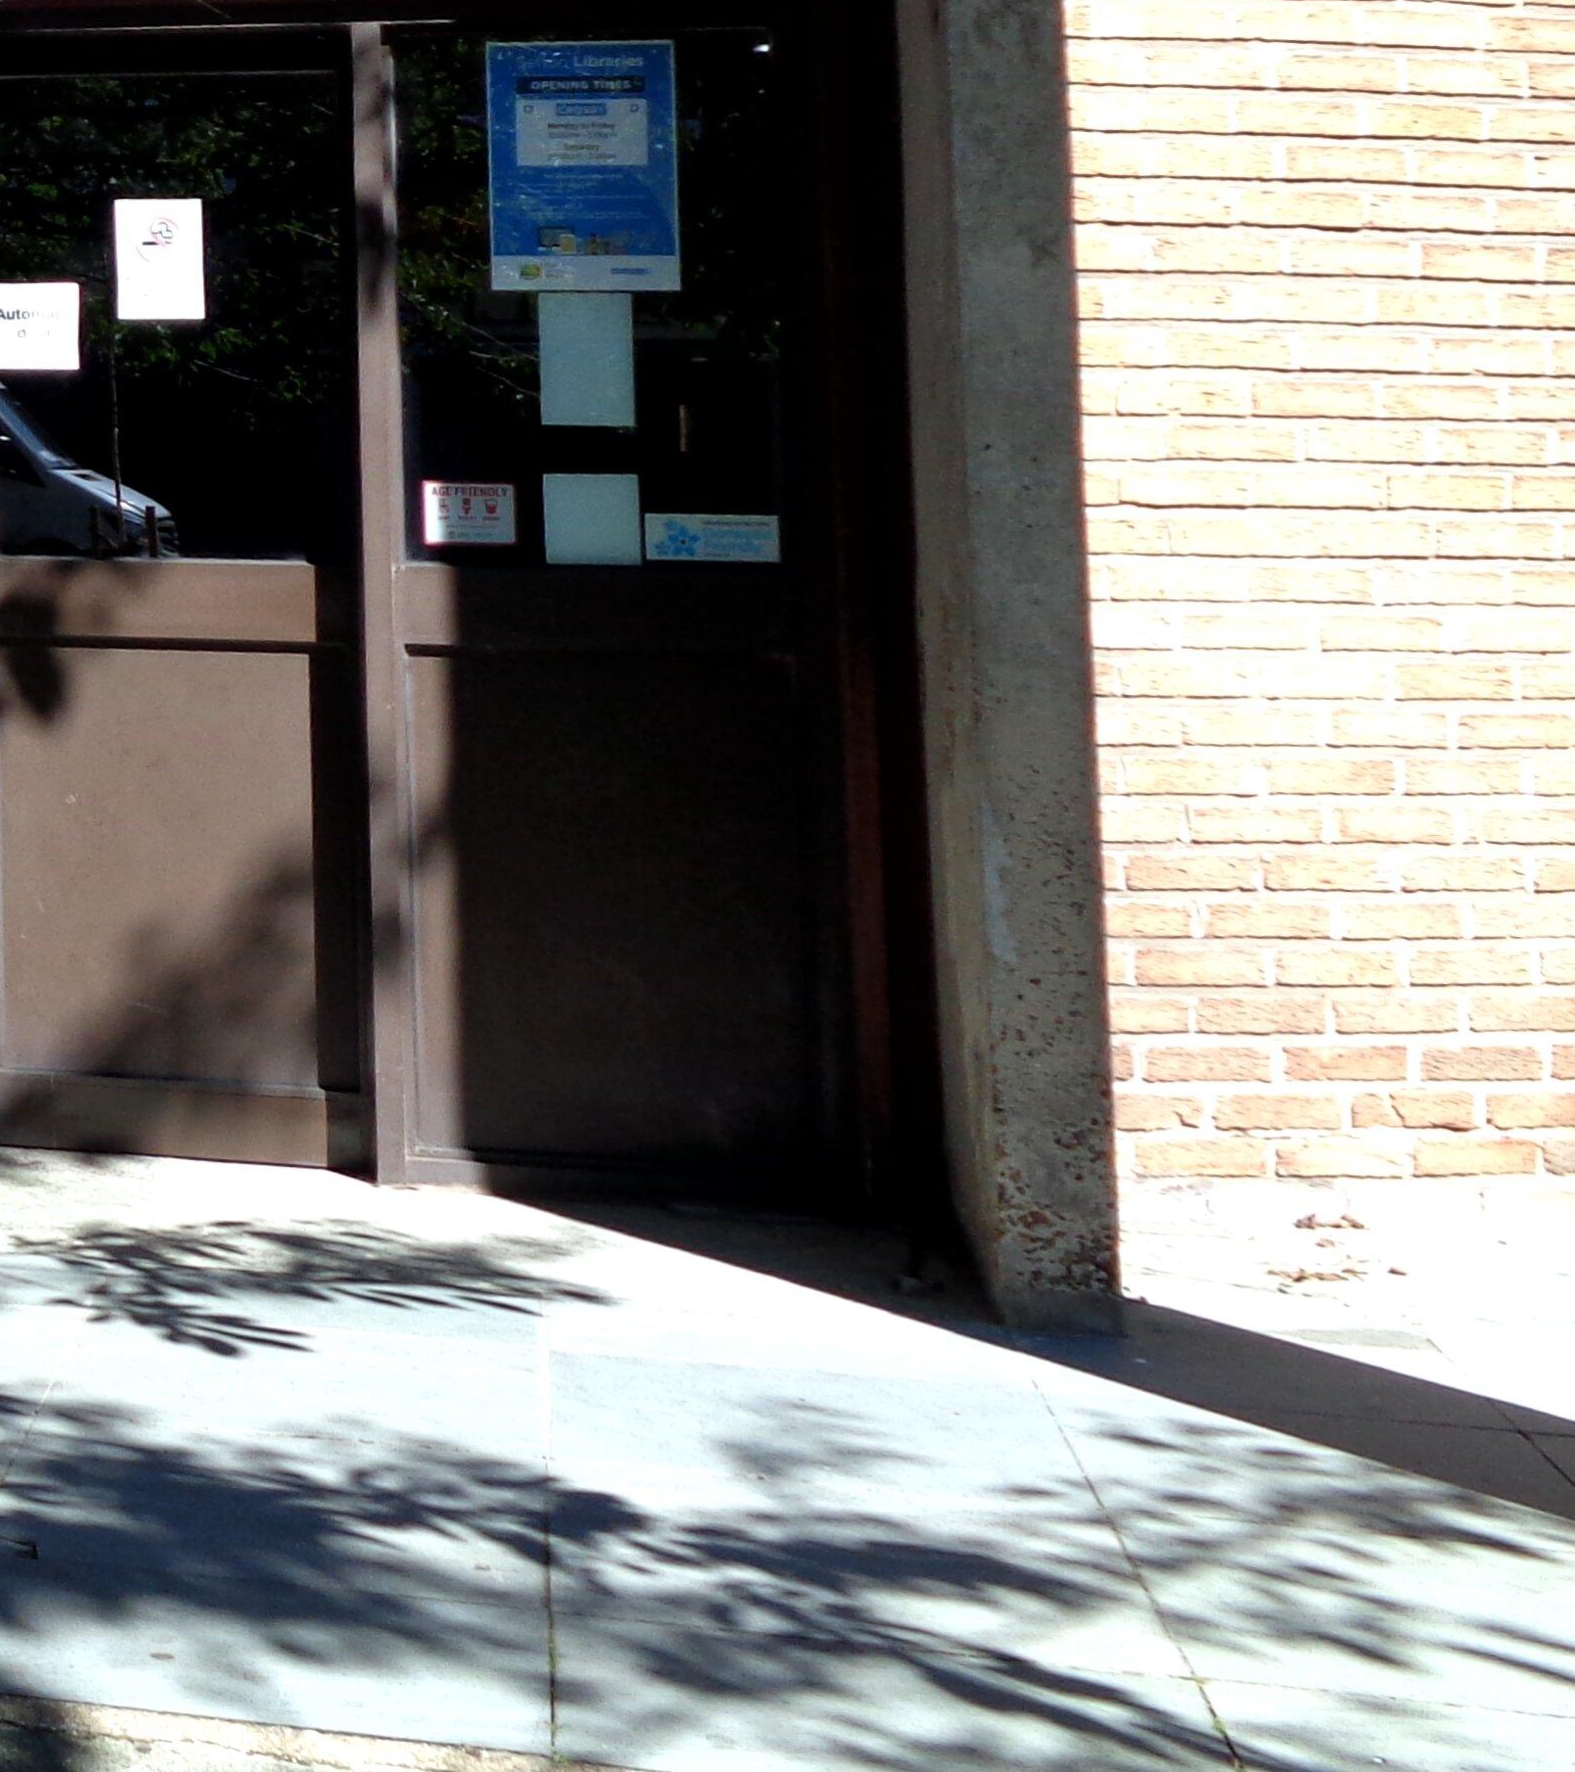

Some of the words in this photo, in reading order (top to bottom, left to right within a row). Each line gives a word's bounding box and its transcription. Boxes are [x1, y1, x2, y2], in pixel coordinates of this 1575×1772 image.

[573, 55, 644, 67] Libraries
[530, 80, 589, 91] OPENING
[593, 80, 632, 90] TIMES
[432, 485, 453, 497] AGE
[454, 486, 508, 498] FRIENDLY
